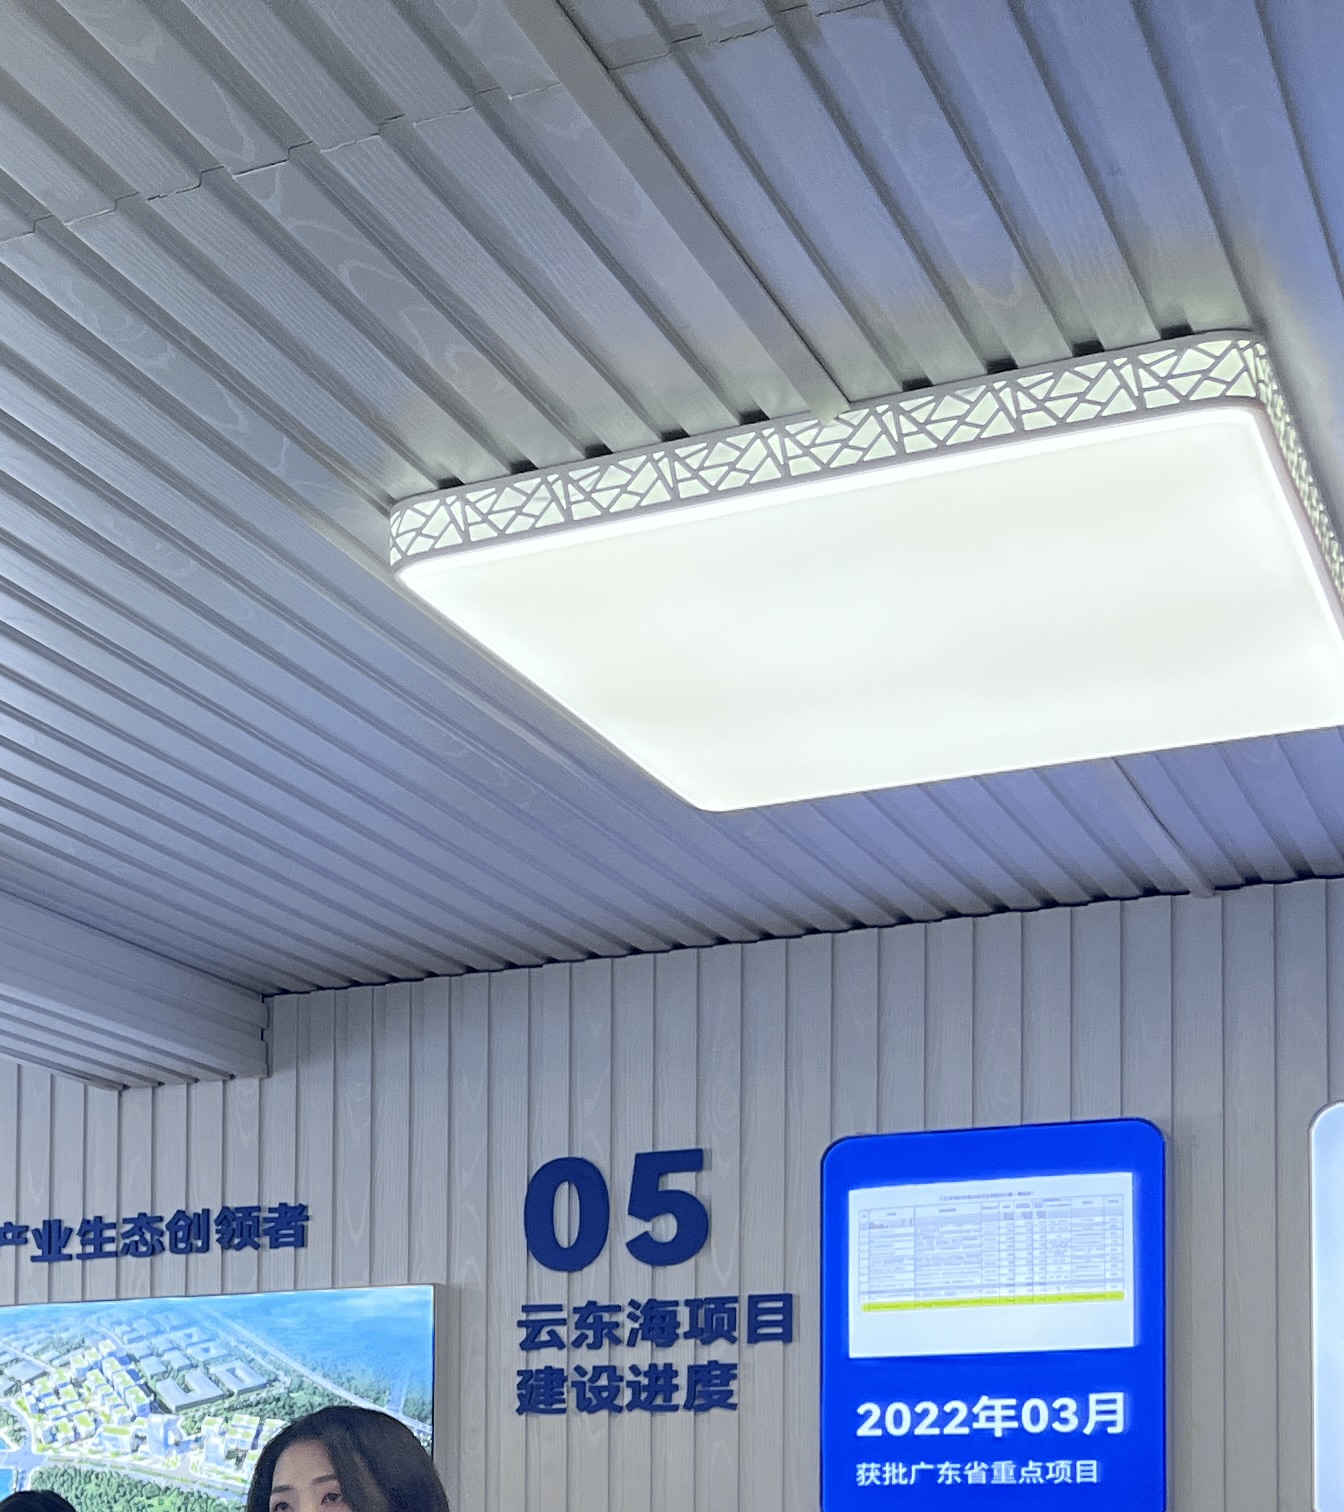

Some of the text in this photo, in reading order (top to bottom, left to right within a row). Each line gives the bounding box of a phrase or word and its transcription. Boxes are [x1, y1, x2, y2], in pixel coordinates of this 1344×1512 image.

[524, 1148, 709, 1273] 05
[516, 1293, 794, 1351] 云东海项目
[515, 1360, 739, 1415] 建设进度
[855, 1391, 1125, 1438] 2022年03月
[855, 1459, 1099, 1487] 获批广东省重点项目
